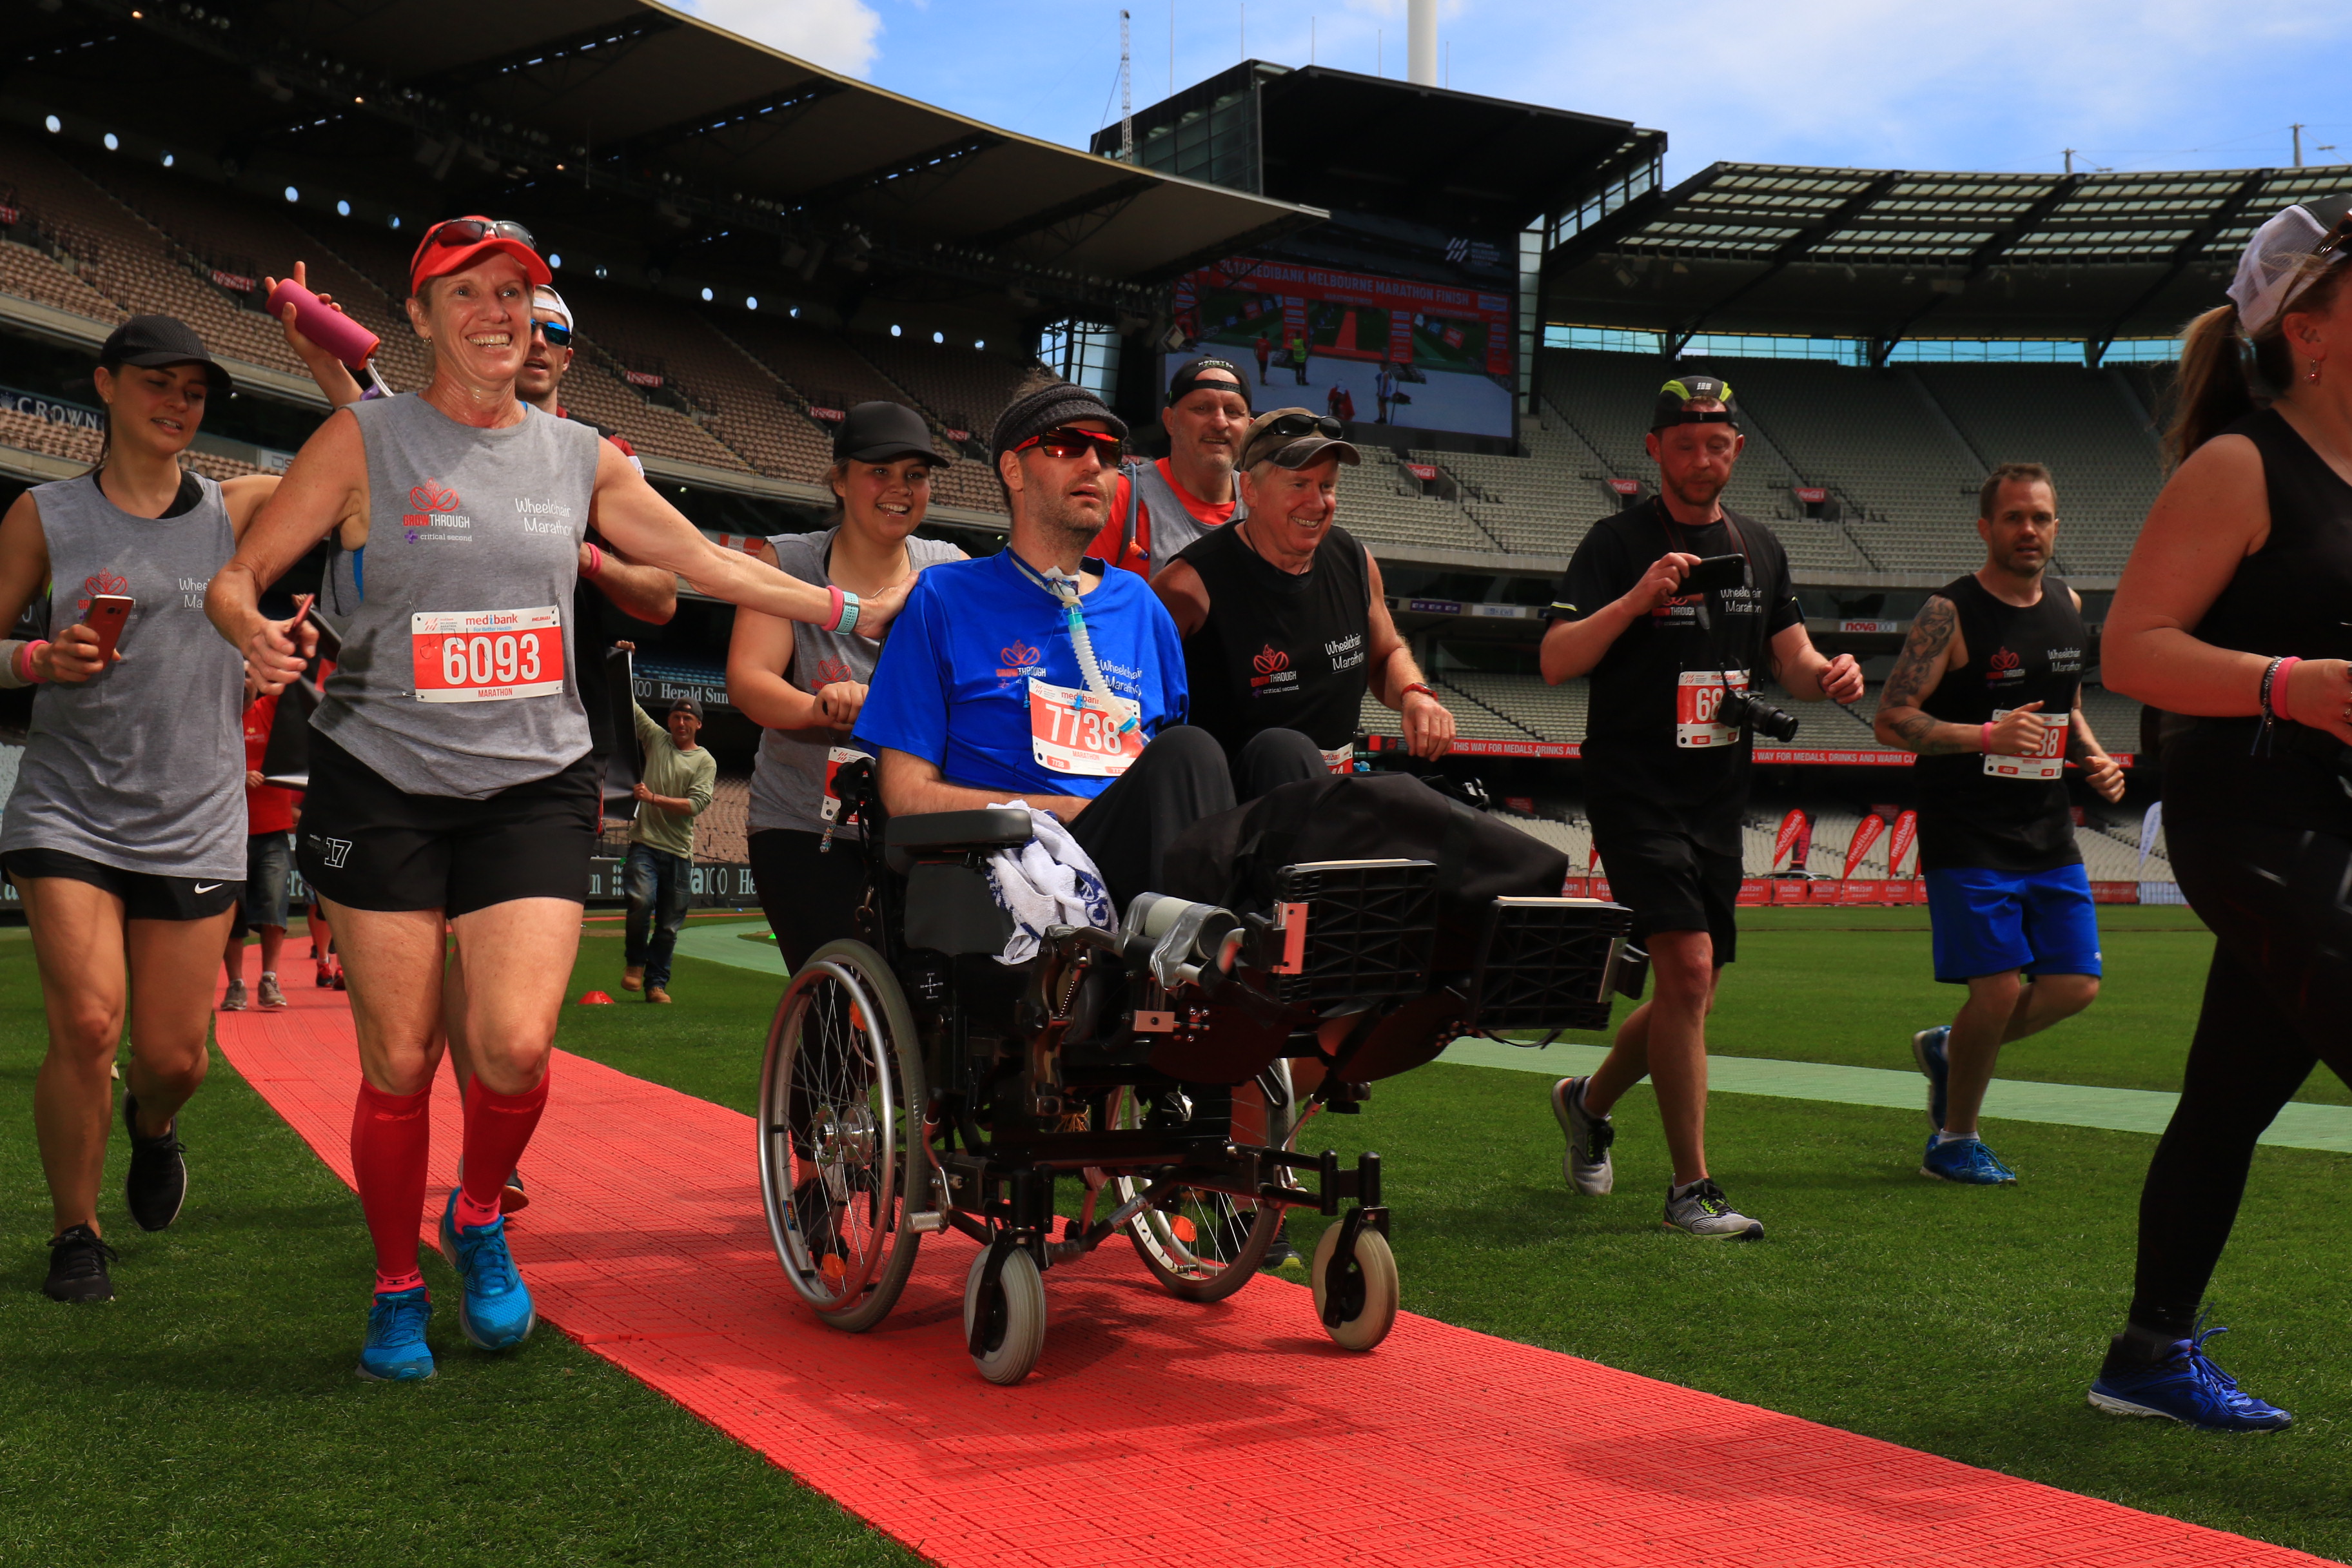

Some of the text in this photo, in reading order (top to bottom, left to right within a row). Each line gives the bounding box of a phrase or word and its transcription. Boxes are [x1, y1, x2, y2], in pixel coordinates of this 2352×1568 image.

[1247, 262, 1305, 284] MEDIBANK
[1308, 271, 1373, 293] MELBOURNE
[1375, 280, 1433, 300] MARATHON
[1436, 289, 1469, 306] FINISH
[17, 397, 97, 430] CROWN
[515, 498, 571, 517] Wheelchair
[1720, 586, 1762, 598] Wheelcair
[466, 614, 518, 626] medibank
[1325, 633, 1362, 656] Wheelchair
[2047, 647, 2081, 660] Wheelchair
[442, 632, 541, 685] 6093
[1332, 651, 1365, 671] Marathon
[1100, 659, 1143, 680] Wheelchair
[478, 688, 513, 698] MARATHON
[661, 683, 702, 702] Herald
[1045, 703, 1122, 754] 7738
[1453, 742, 1469, 751] THIS
[1471, 743, 1487, 752] WAY
[1488, 743, 1502, 752] FOR
[1504, 744, 1534, 754] MEDALS,
[1536, 745, 1563, 755] DRINKS
[2035, 729, 2060, 757] 38
[1072, 750, 1100, 761] MARATHON
[1793, 753, 1827, 763] MEDALS,
[1828, 754, 1857, 762] DRINKS
[1774, 812, 1803, 856] medibank
[1848, 818, 1879, 862] medibank
[1891, 814, 1915, 858] medibank
[324, 837, 353, 868] 17
